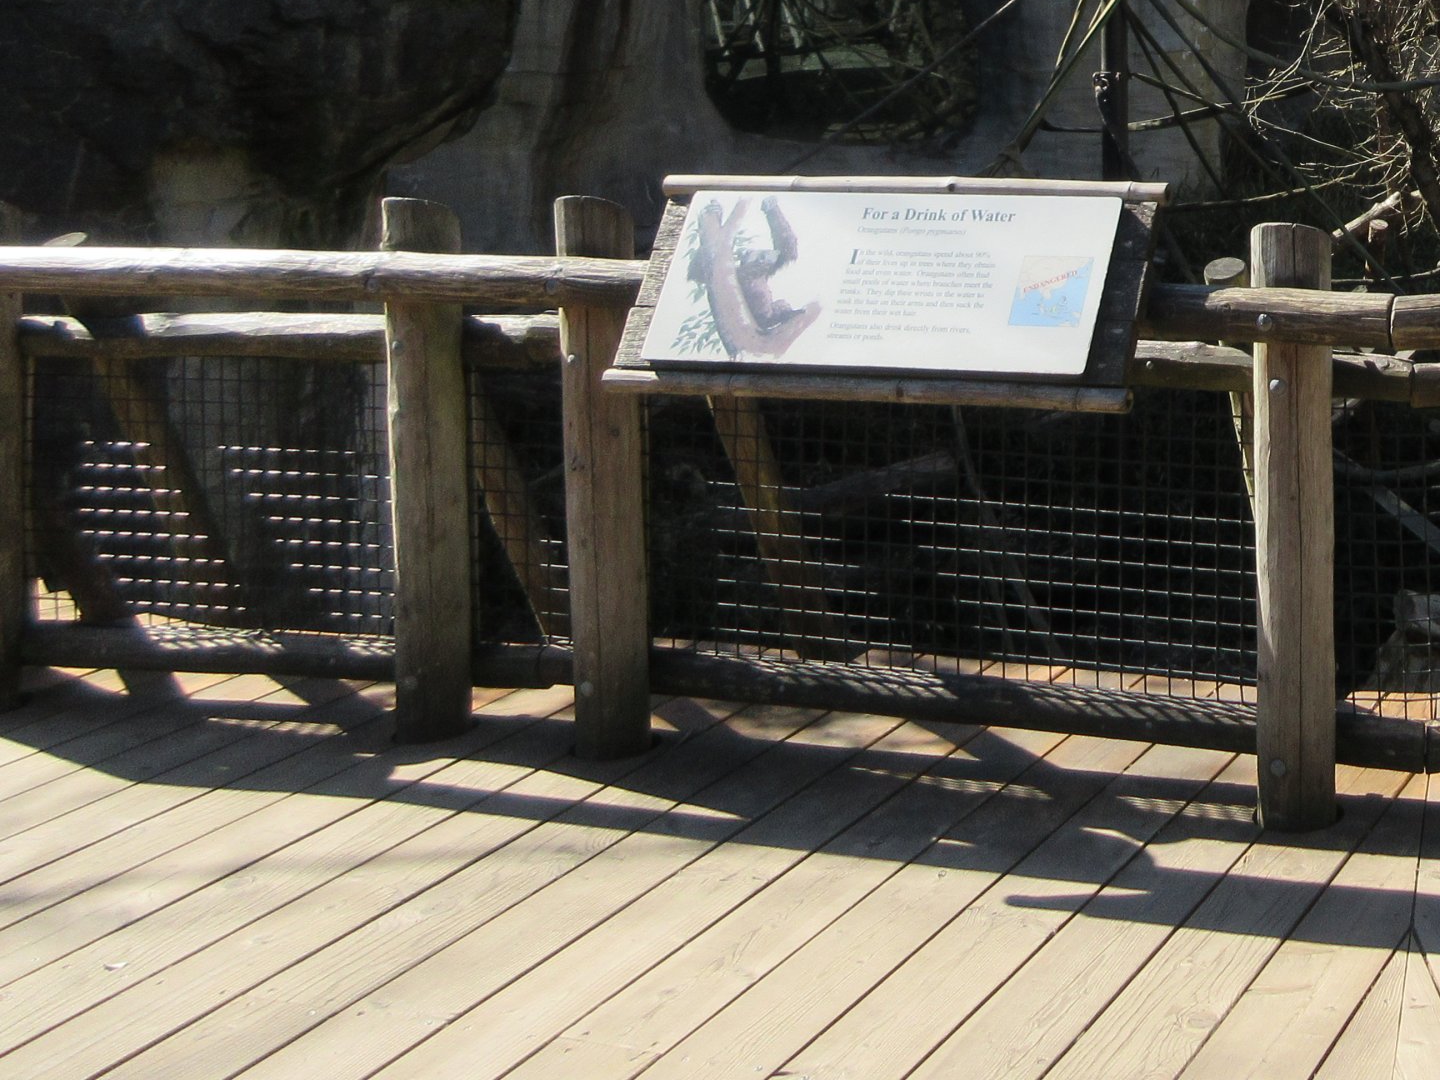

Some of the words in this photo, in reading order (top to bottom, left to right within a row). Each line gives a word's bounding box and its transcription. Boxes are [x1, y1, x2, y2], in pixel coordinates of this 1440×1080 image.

[862, 207, 889, 220] For
[891, 211, 900, 220] a
[904, 208, 948, 221] Drink
[951, 209, 968, 221] of
[972, 209, 1016, 222] Water
[857, 225, 898, 235] Orangutans
[934, 251, 954, 259] spend
[957, 261, 972, 270] they
[916, 269, 955, 279] Orangutans
[1022, 269, 1079, 294] ENDANGERED
